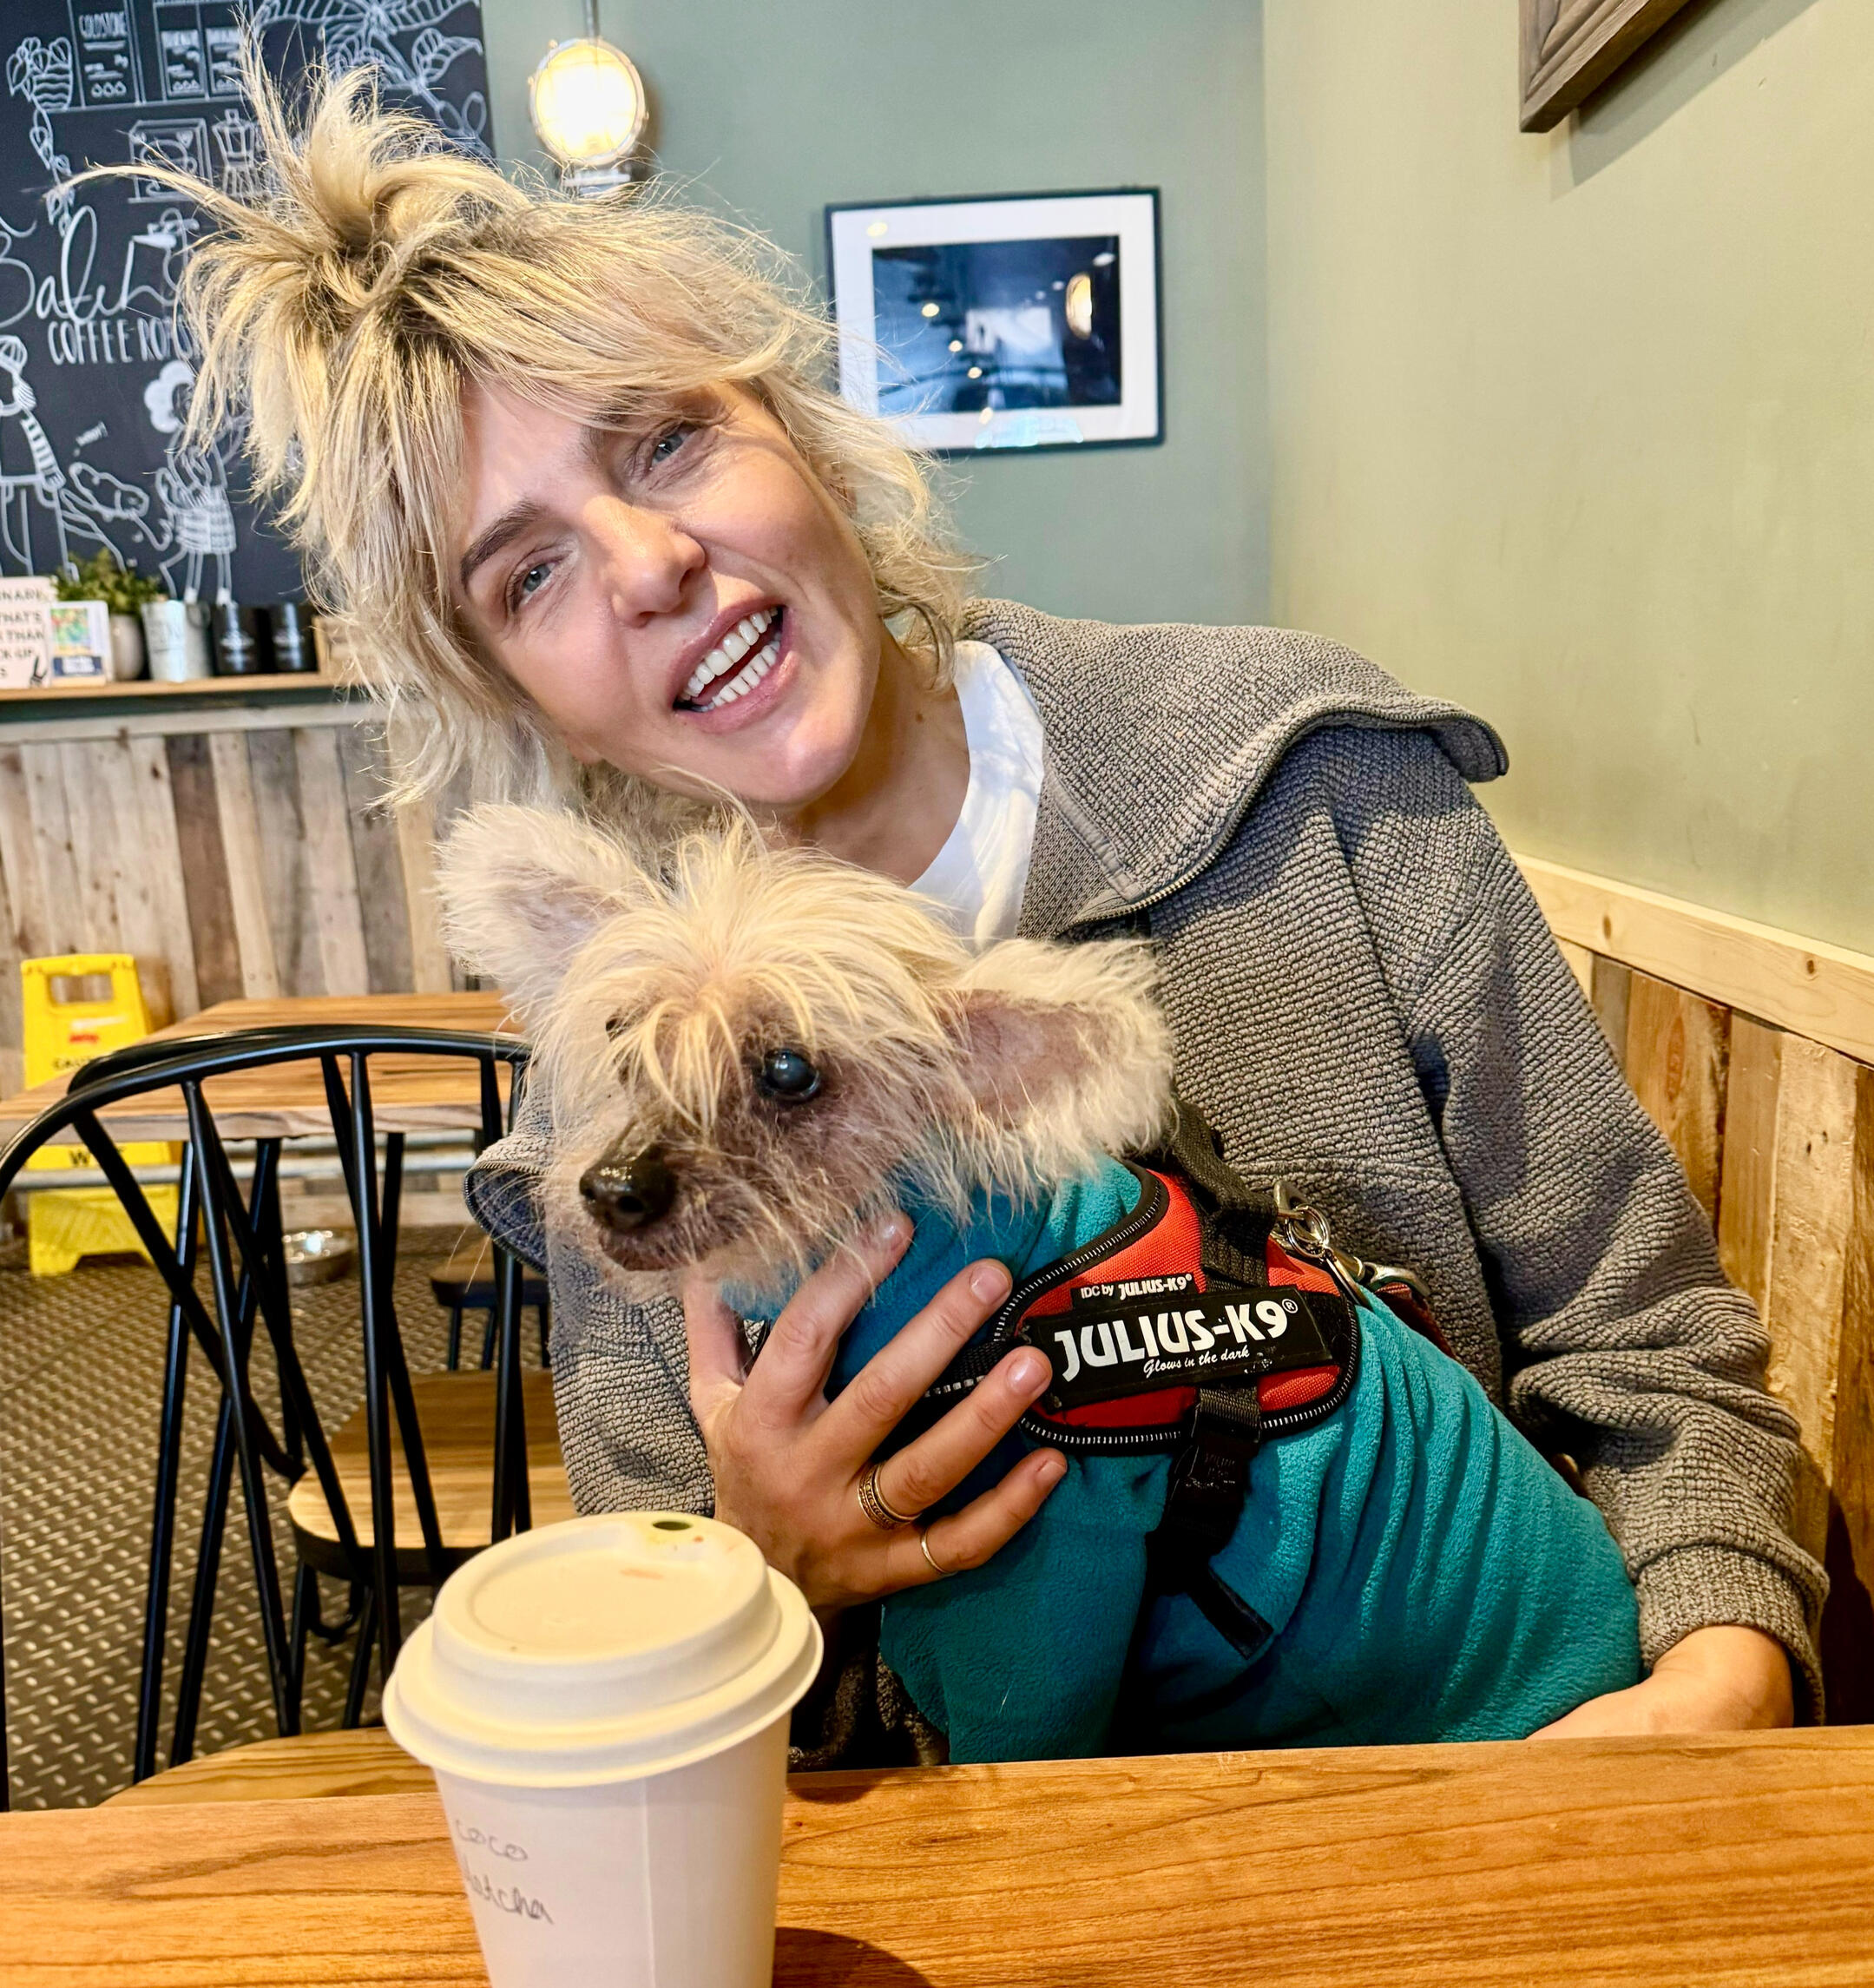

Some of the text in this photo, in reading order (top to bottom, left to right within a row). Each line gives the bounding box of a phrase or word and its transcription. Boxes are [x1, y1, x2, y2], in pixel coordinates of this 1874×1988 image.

[48, 319, 133, 365] COFFEE
[1080, 1286, 1101, 1299] IDC
[1101, 1284, 1115, 1297] by
[1143, 1345, 1250, 1379] Glows in the dark
